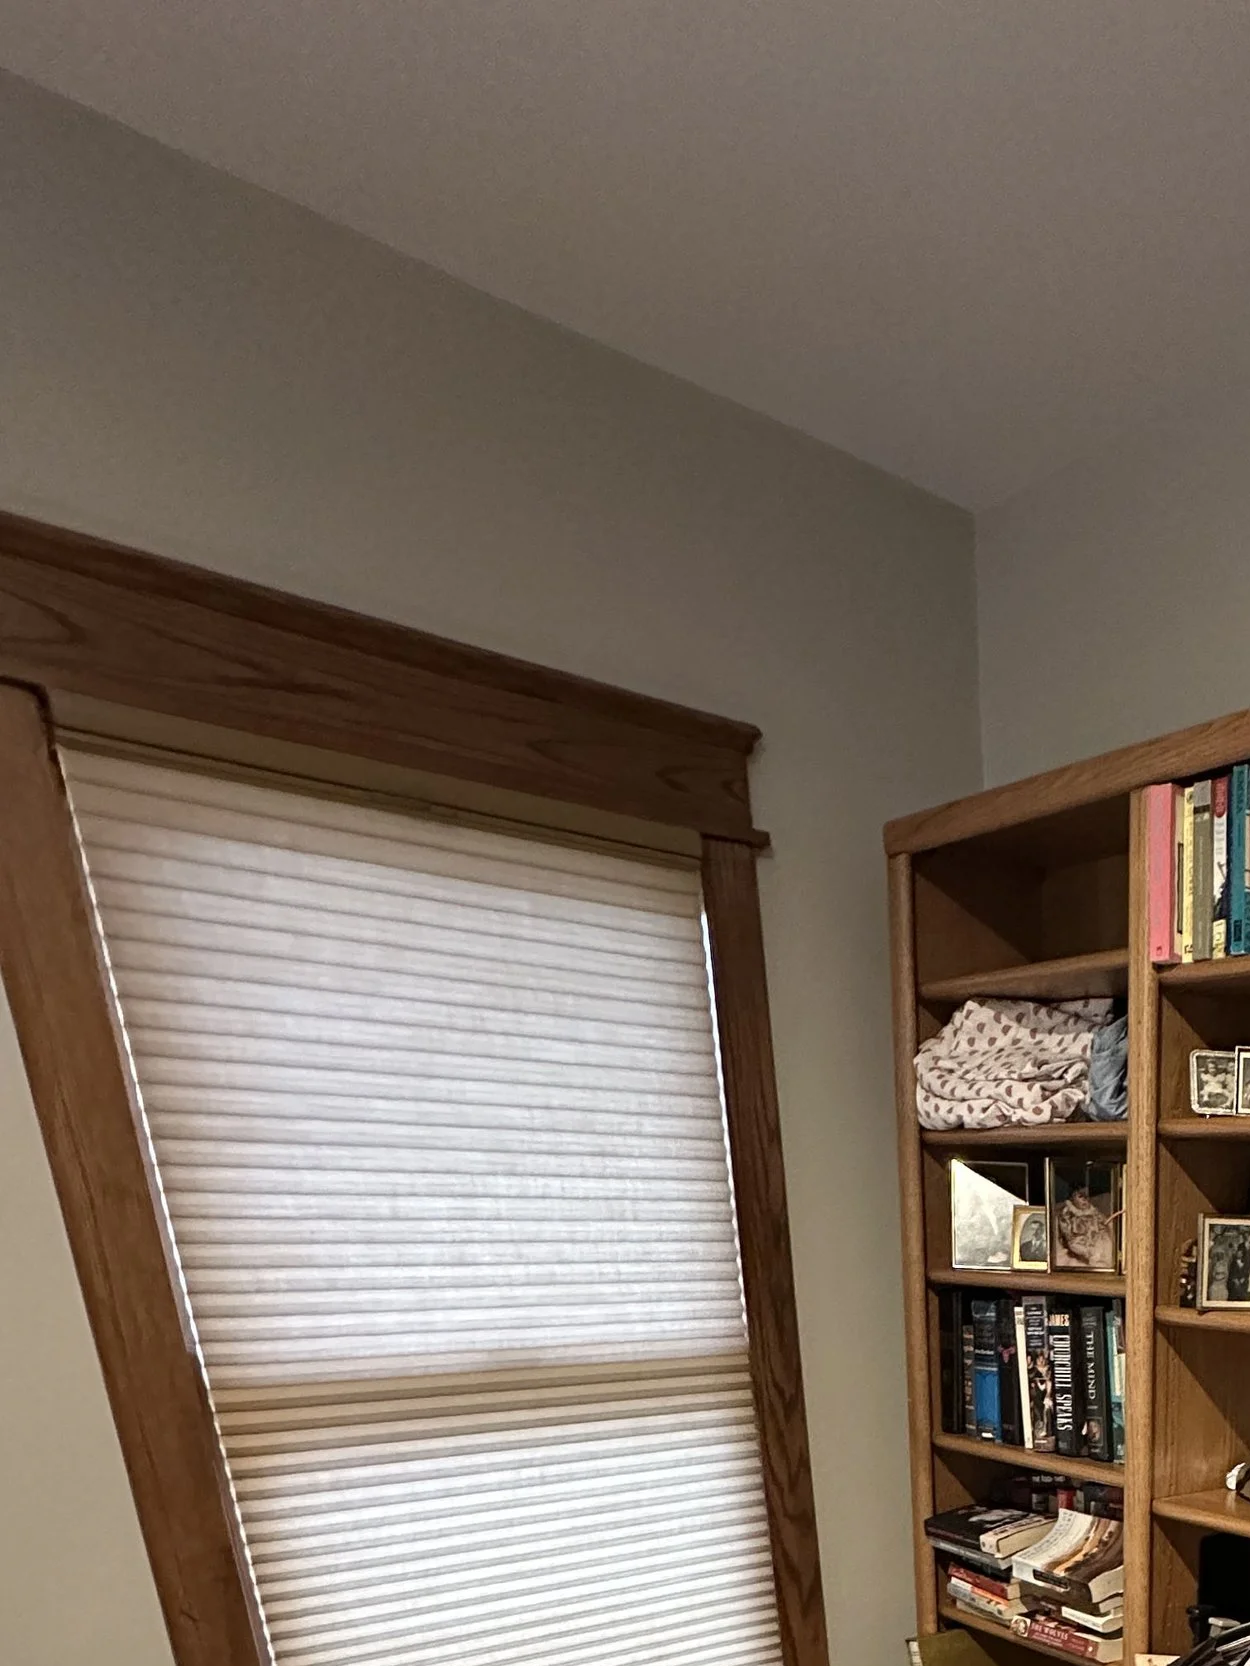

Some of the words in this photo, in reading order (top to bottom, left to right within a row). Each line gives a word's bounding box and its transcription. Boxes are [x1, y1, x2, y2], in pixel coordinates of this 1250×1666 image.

[1085, 1332, 1094, 1357] THE
[1087, 1362, 1096, 1400] MIND
[1057, 1394, 1074, 1431] SPEAKS
